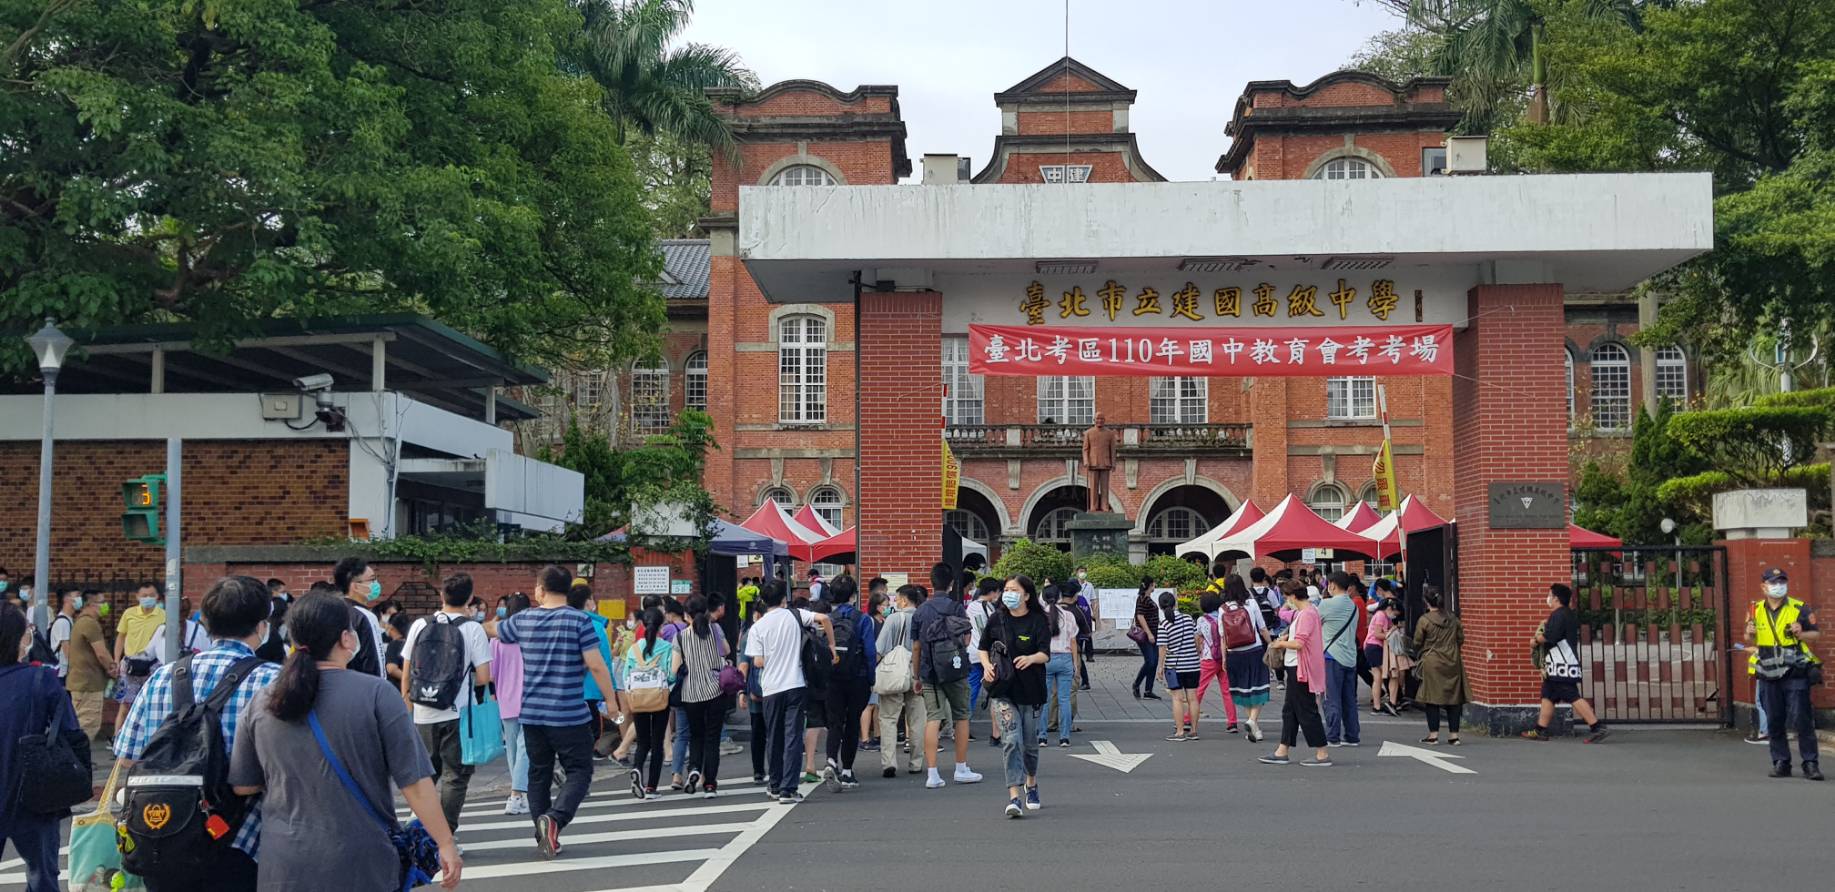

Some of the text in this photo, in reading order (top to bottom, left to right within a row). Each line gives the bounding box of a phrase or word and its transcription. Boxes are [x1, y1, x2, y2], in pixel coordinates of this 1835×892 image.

[1019, 279, 1399, 326] 臺北市立建國高級中學
[984, 333, 1440, 366] 臺北考區110年國中教育會考考場
[1376, 447, 1391, 507] 勿跟車
[1544, 661, 1582, 678] dida
